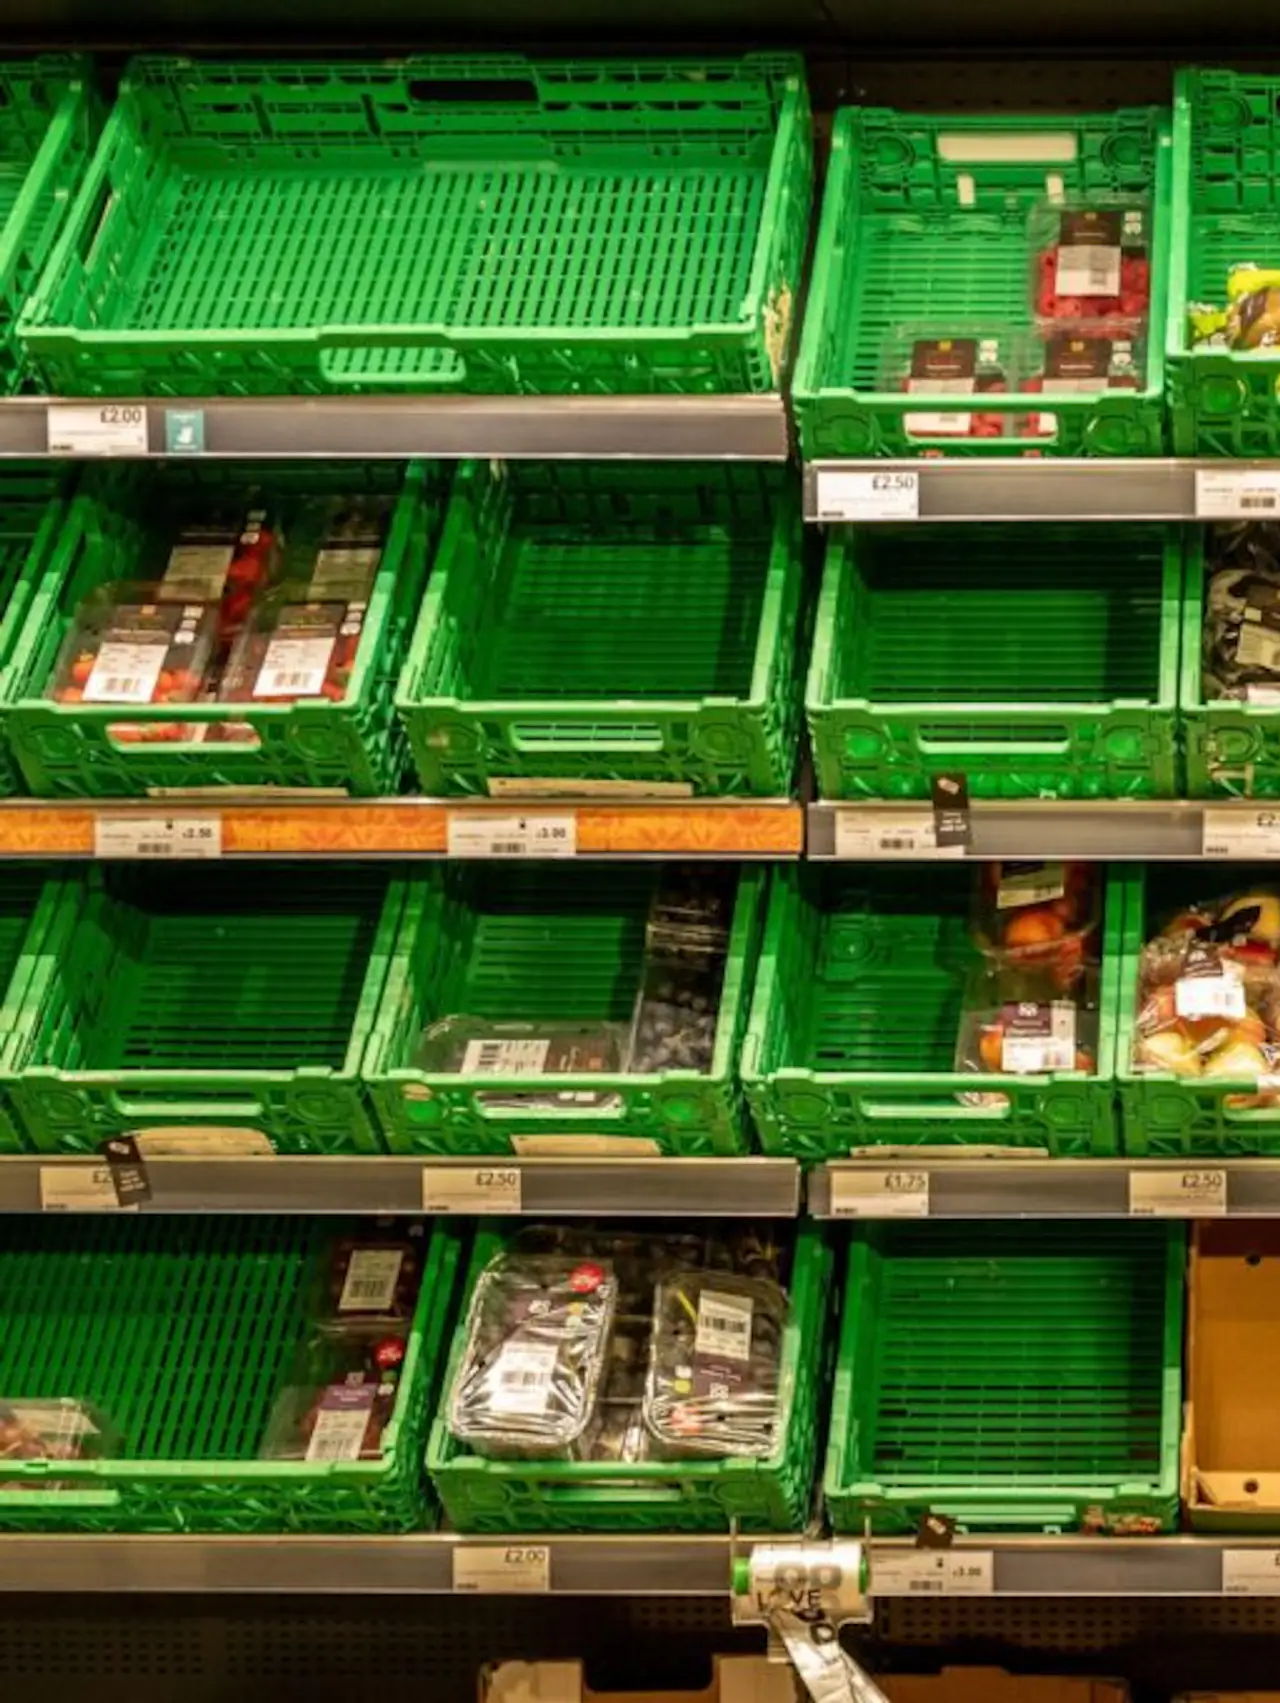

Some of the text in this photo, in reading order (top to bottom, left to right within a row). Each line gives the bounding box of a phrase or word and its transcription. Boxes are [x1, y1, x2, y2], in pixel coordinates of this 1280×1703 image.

[100, 407, 142, 424] £2.00
[872, 474, 914, 491] £2.50
[475, 1172, 517, 1188] £2.50
[885, 1172, 926, 1188] £1.75
[1181, 1172, 1222, 1188] £2.50
[505, 1549, 546, 1564] £2.00
